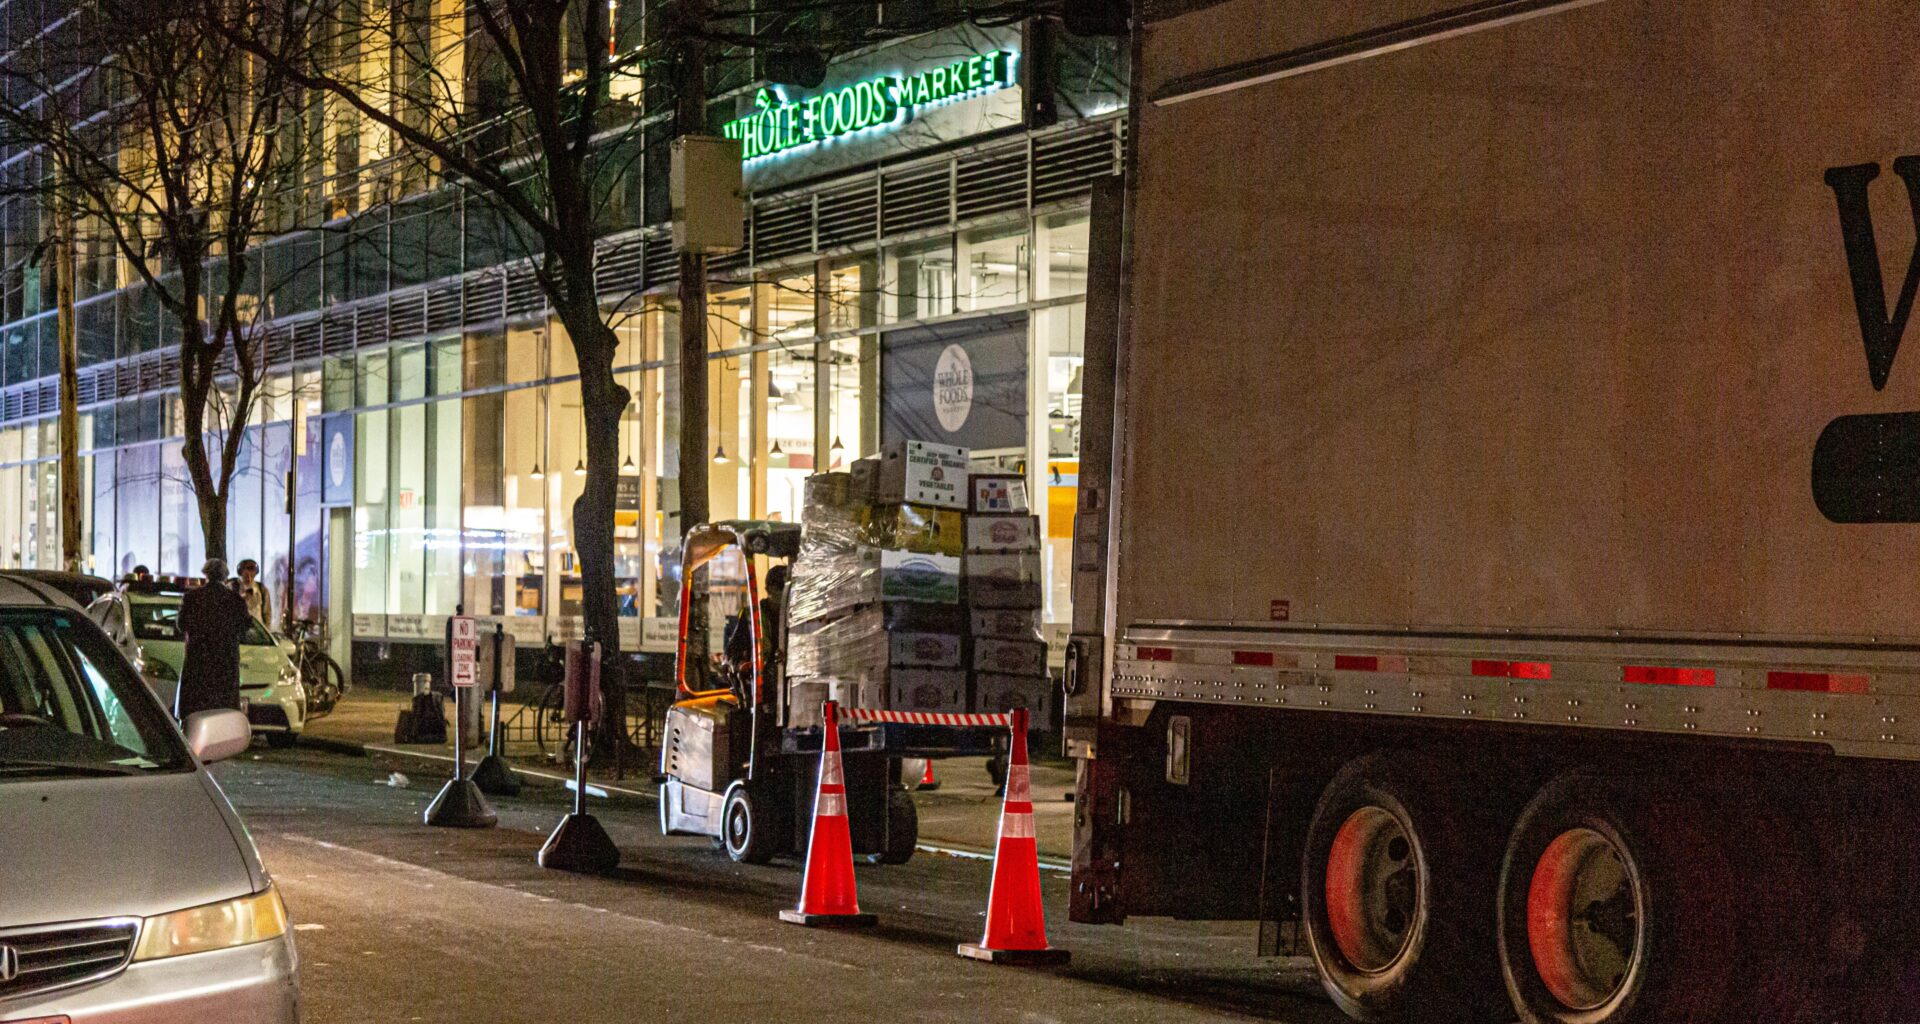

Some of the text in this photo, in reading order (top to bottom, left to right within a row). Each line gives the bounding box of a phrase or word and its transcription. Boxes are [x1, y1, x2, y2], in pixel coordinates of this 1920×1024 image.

[806, 76, 886, 141] FOODS
[899, 50, 1000, 105] MARKET
[938, 366, 969, 387] WHOLE
[939, 386, 969, 405] FOODS
[909, 455, 939, 465] CERTIFIED
[941, 459, 966, 469] ORGANIC
[918, 480, 954, 491] VEGETABLES
[459, 622, 469, 636] NO
[453, 638, 475, 650] PARKING
